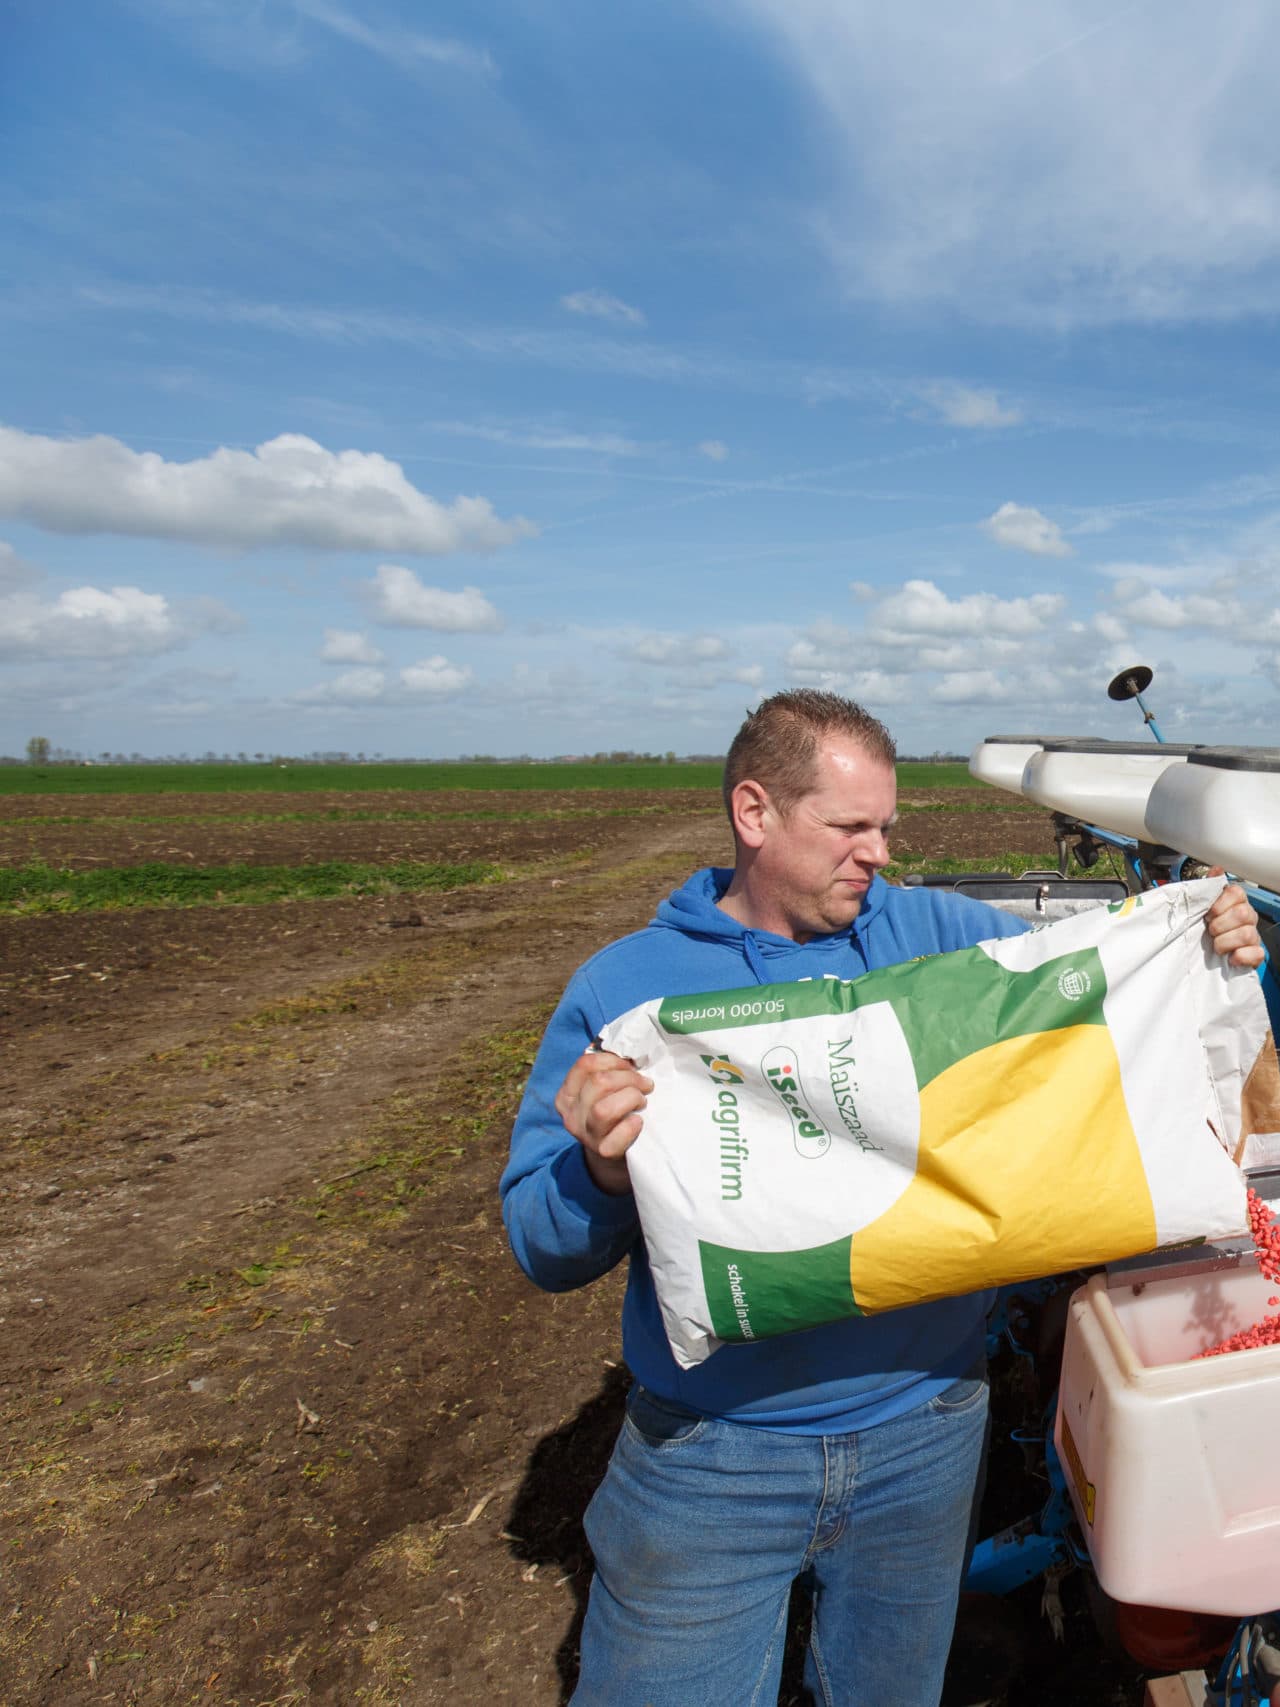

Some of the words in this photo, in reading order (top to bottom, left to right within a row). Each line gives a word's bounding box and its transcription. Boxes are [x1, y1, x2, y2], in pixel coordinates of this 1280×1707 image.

[672, 1006, 725, 1025] korrels
[730, 999, 785, 1018] 50.000
[827, 1035, 884, 1153] Maïszaad
[711, 1090, 749, 1201] agrifirm
[727, 1264, 749, 1308] schakel
[735, 1308, 750, 1318] in
